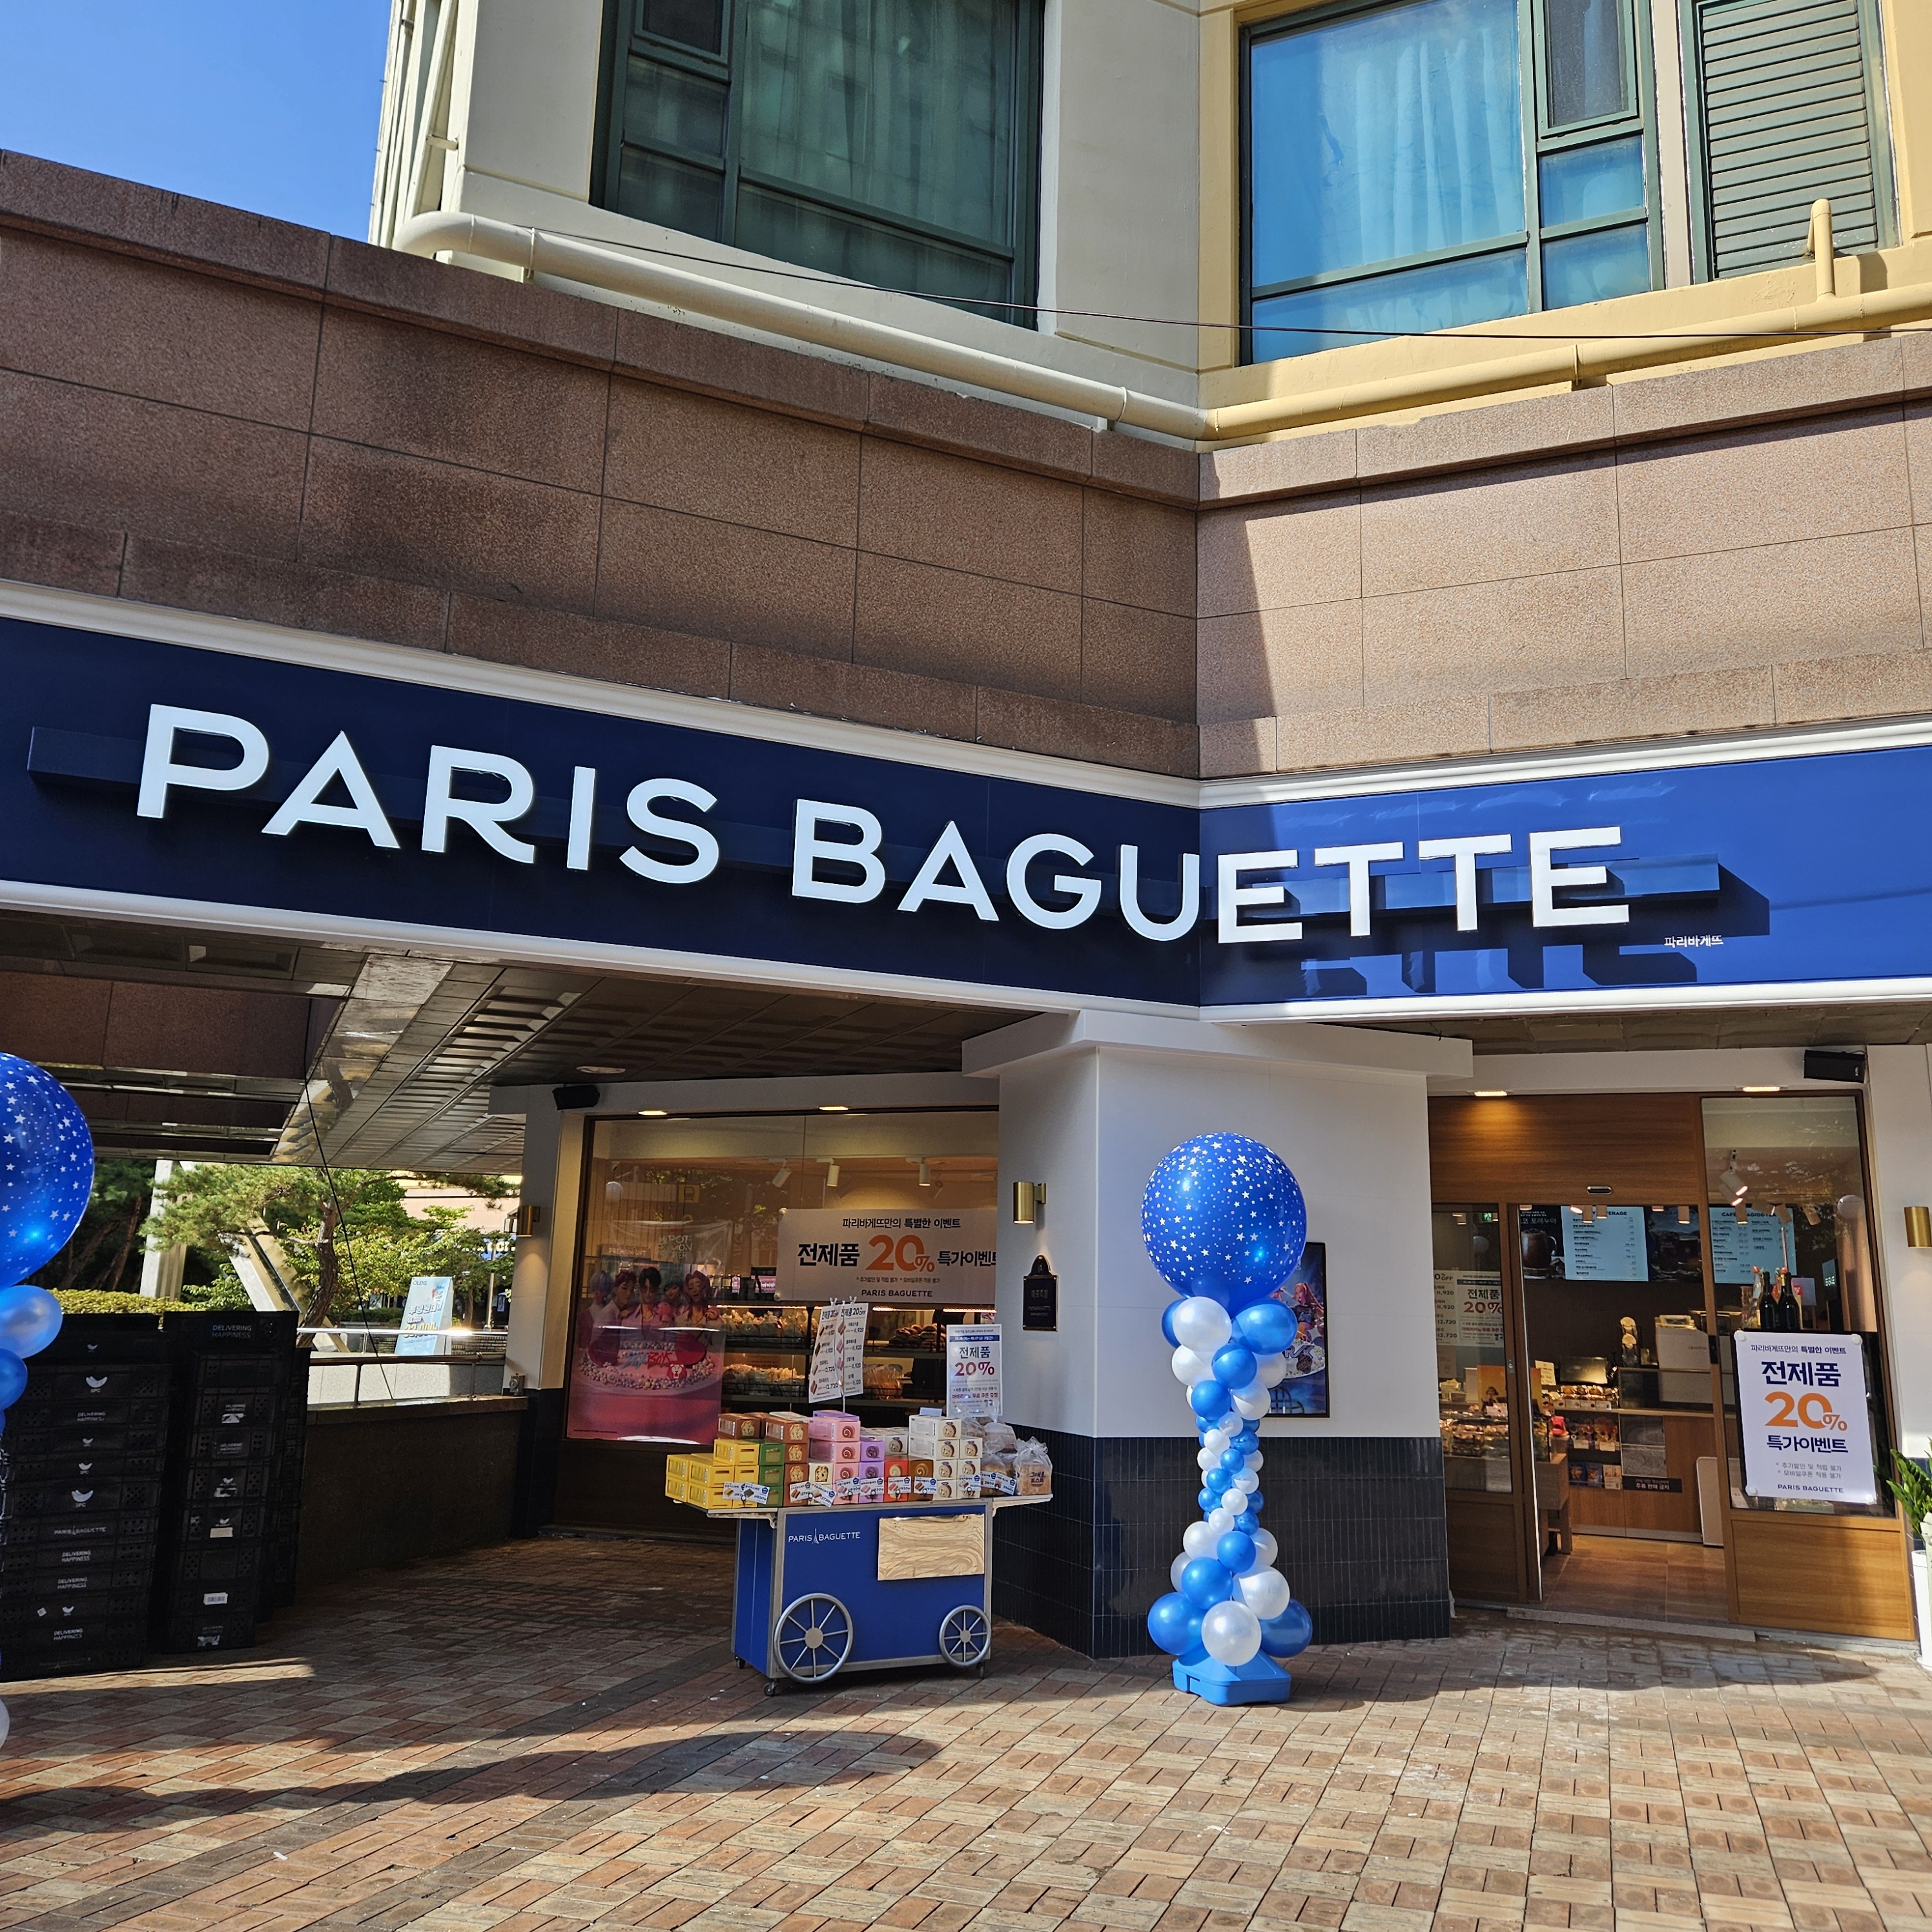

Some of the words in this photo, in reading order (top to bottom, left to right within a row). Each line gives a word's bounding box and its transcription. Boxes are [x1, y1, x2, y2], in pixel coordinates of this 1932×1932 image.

[137, 703, 719, 884] PARIS
[792, 798, 1630, 943] BAGUETTE
[1664, 935, 1723, 948] 파리바게뜨
[842, 1218, 901, 1228] 파리바게뜨만의
[904, 1218, 931, 1228] 특별한
[934, 1218, 961, 1229] 이벤트
[797, 1242, 860, 1267] 전제품
[865, 1234, 935, 1273] 20%
[1467, 1289, 1500, 1300] 전제품
[1463, 1301, 1503, 1314] 20%
[959, 1346, 991, 1359] 전제품
[1751, 1344, 1798, 1353] 파리바게뜨만의
[1801, 1346, 1822, 1354] 특별한
[1825, 1346, 1847, 1355] 이벤트
[954, 1361, 995, 1376] 20%
[1761, 1361, 1841, 1388] 전제품
[1764, 1391, 1848, 1431] 20%
[1767, 1435, 1849, 1453] 특가이벤트
[1802, 1485, 1844, 1494] BAGUETTE
[788, 1534, 812, 1543] PARIS
[818, 1532, 861, 1541] BAGUETTE
